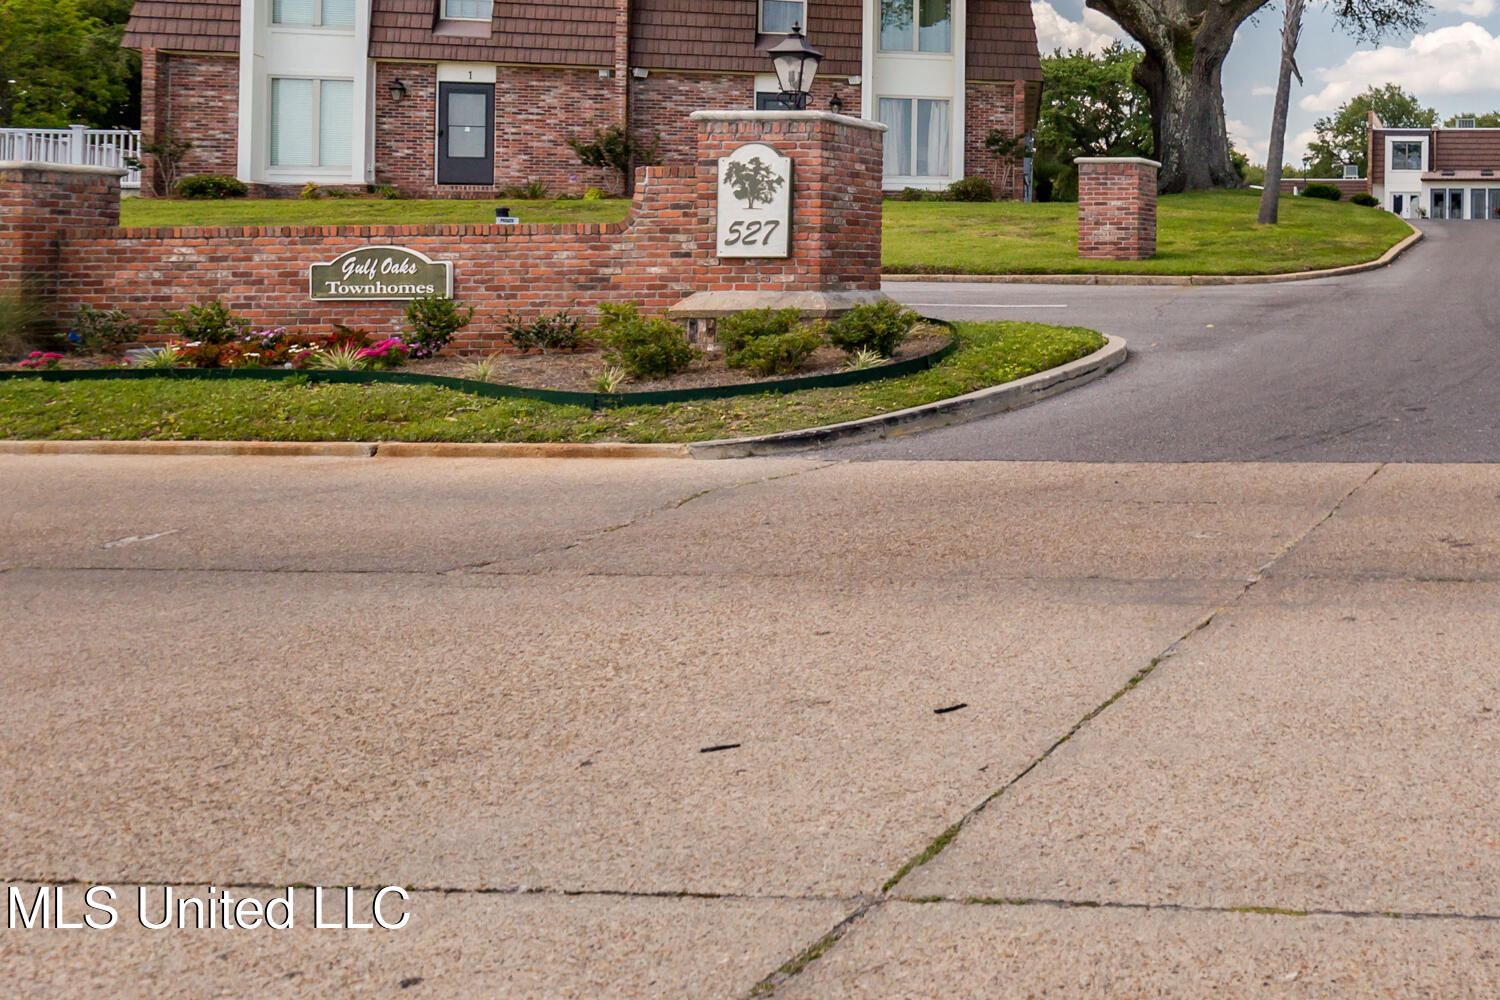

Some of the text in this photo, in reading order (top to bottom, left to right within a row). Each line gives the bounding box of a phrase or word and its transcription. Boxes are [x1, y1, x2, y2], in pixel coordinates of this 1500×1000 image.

[724, 219, 780, 246] 527
[341, 256, 418, 280] Gulf Oaks
[325, 281, 435, 295] Townhomes
